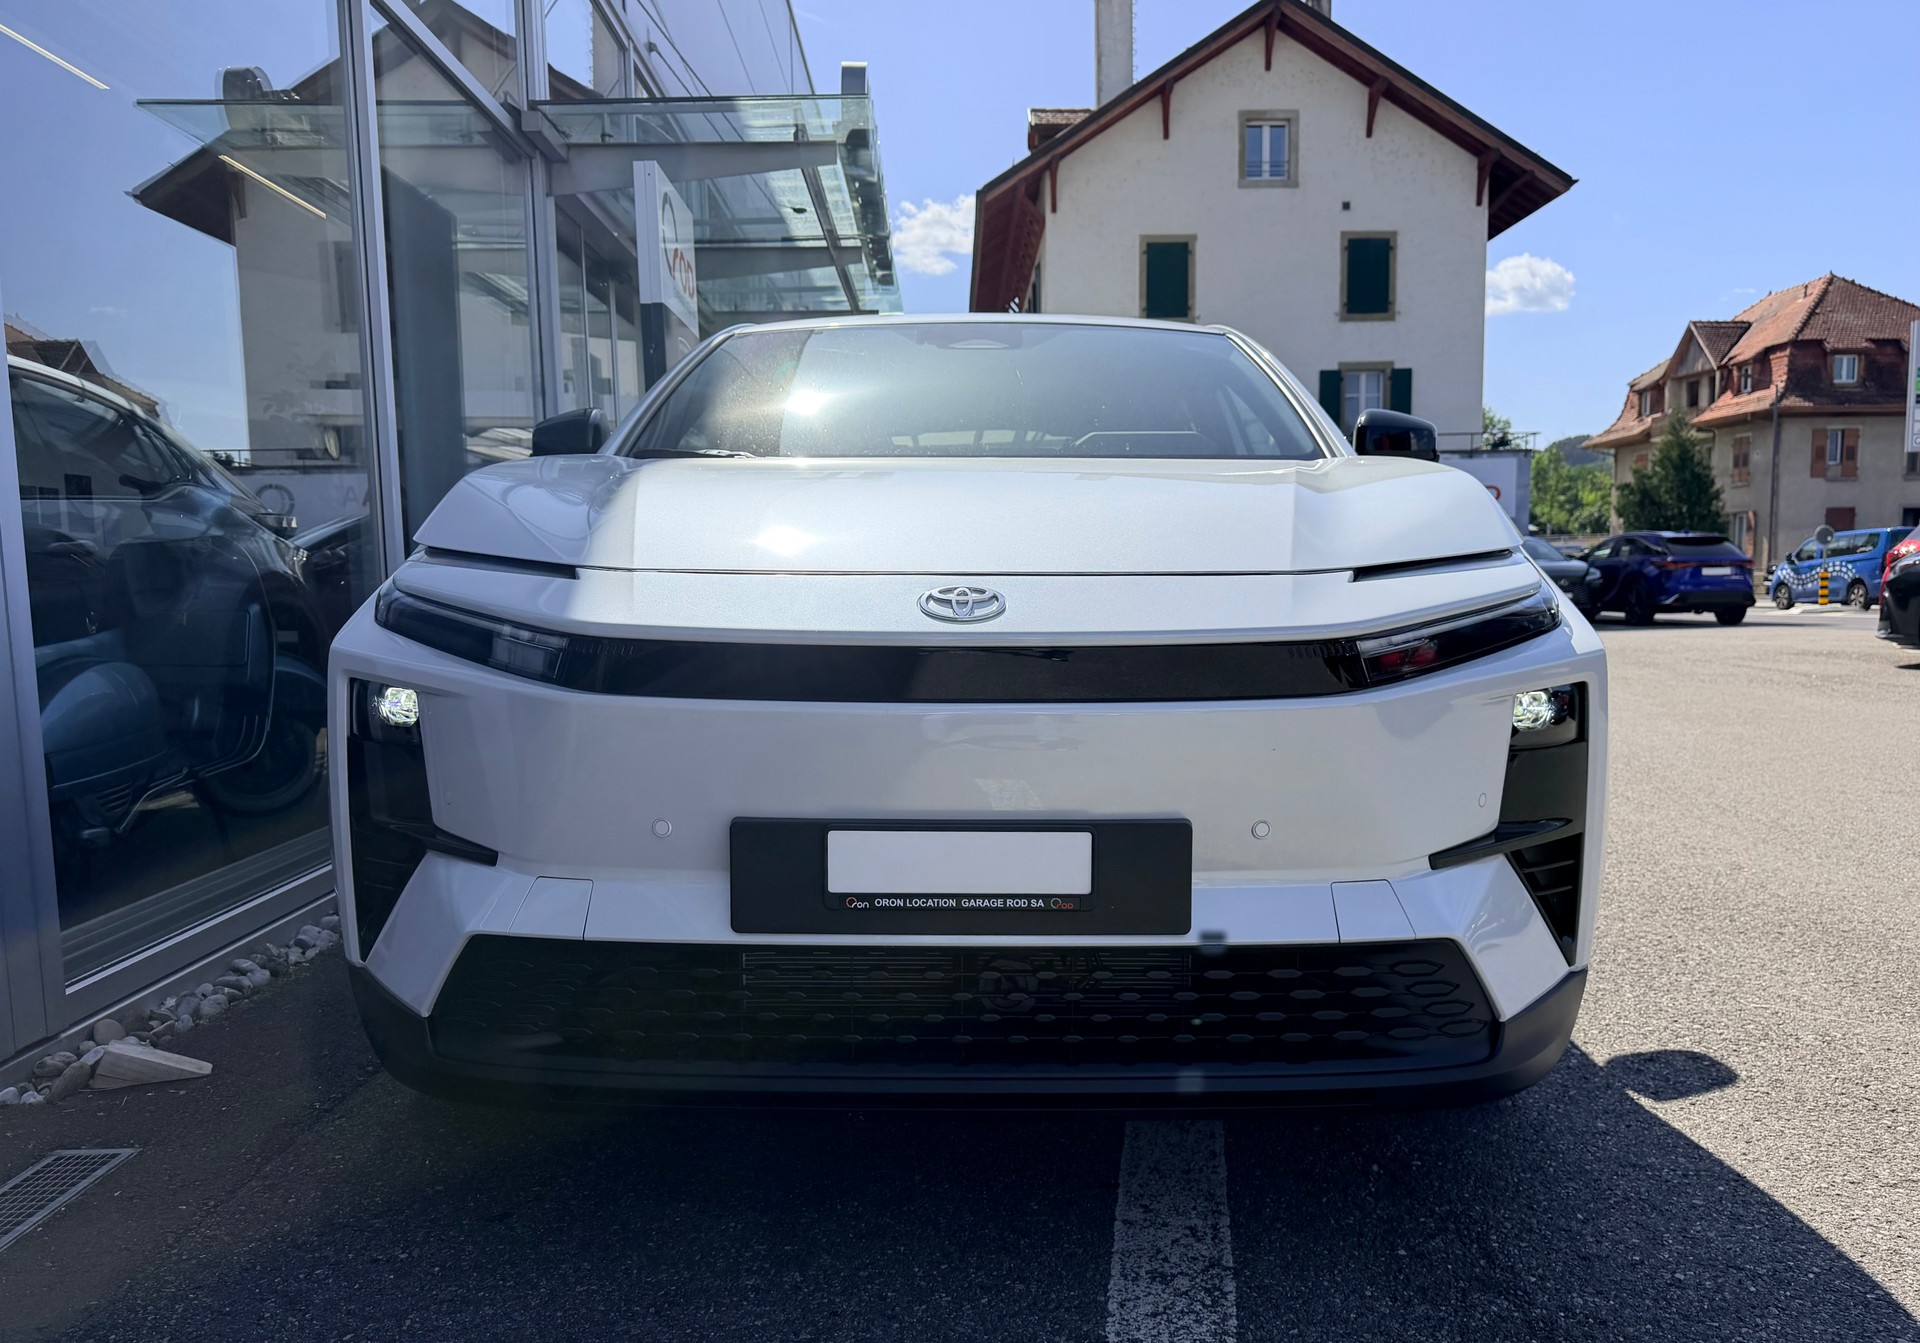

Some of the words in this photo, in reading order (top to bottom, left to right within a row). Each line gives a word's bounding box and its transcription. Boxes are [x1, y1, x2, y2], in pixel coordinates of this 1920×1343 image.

[874, 898, 904, 907] ORON
[906, 898, 956, 907] LOCATION
[961, 898, 1004, 908] GARAGE
[1006, 898, 1028, 908] ROD
[1030, 898, 1045, 908] SA
